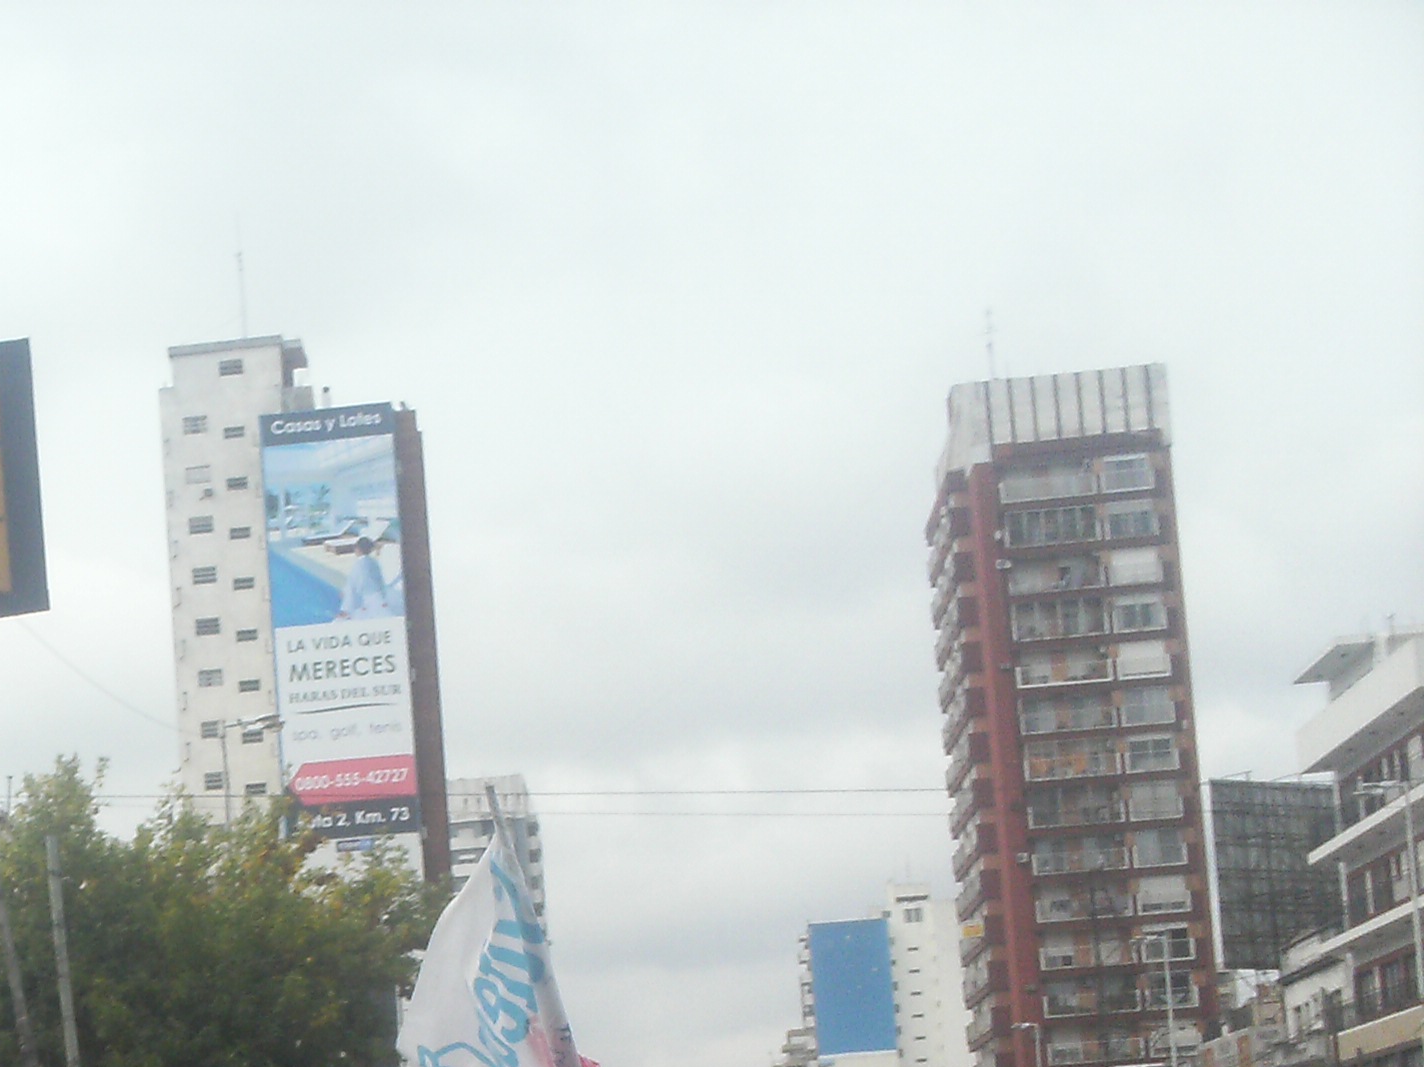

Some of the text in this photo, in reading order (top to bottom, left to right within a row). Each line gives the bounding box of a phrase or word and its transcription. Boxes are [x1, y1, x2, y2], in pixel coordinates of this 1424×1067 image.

[270, 411, 382, 435] Casas y Lotes
[287, 630, 391, 654] LA VIDA QUE
[289, 654, 396, 683] MERECES
[289, 683, 402, 704] HARAS DEL SUR
[354, 809, 387, 826] Km.
[390, 806, 411, 822] 73
